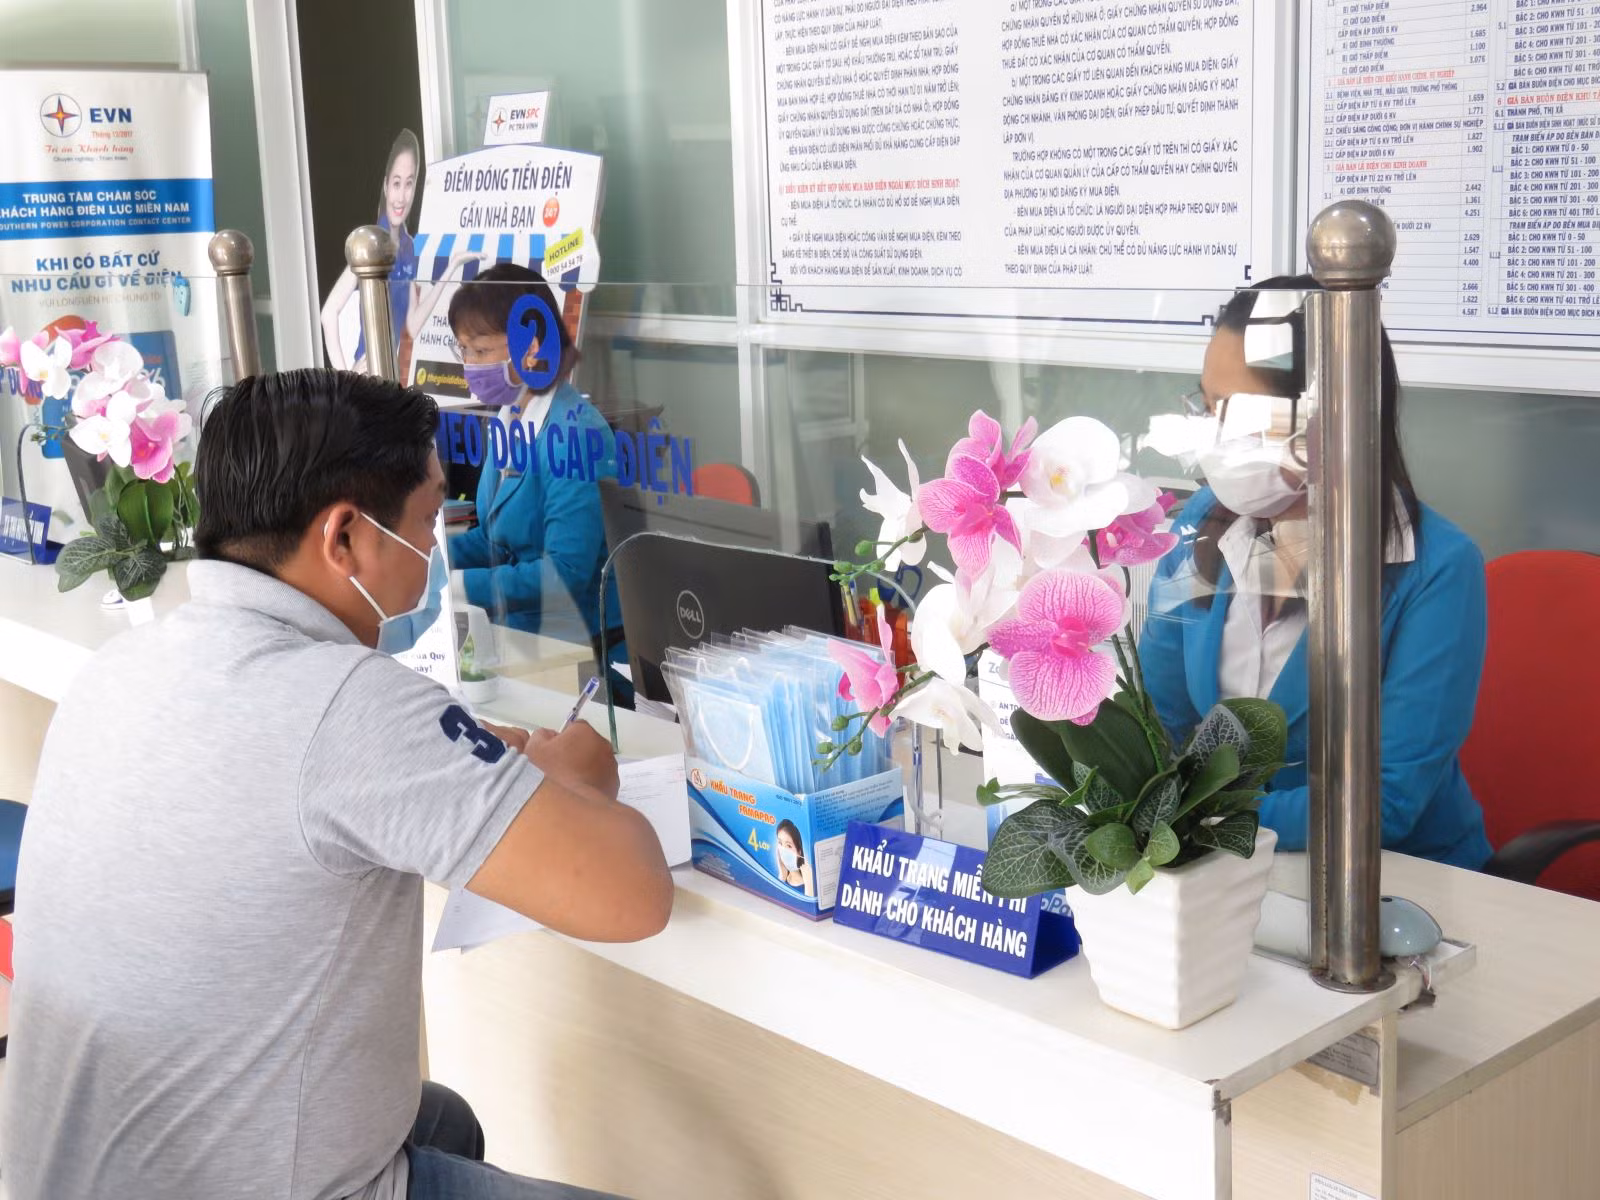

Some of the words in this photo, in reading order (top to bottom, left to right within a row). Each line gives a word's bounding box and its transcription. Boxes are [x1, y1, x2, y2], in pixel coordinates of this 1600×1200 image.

[90, 108, 132, 123] EVN
[444, 162, 473, 192] ĐIỂM
[475, 165, 508, 191] ĐÓNG
[512, 160, 539, 190] TIỀN
[541, 161, 573, 196] ĐIỆN
[23, 193, 65, 204] TRUNG
[69, 189, 93, 202] TÂM
[97, 189, 131, 202] CHĂM
[134, 188, 157, 200] SÓC
[41, 203, 73, 217] HÀNG
[77, 202, 105, 216] ĐIỆN
[136, 200, 161, 214] MIỀN
[165, 202, 189, 213] NAM
[41, 220, 69, 229] POWER
[71, 219, 126, 228] CORPORATION
[128, 217, 160, 226] CONTACT
[162, 216, 191, 225] CENTER
[459, 202, 482, 228] GẦN
[484, 202, 508, 229] NHÀ
[511, 205, 535, 233] BẠN
[36, 258, 68, 271] KHI
[73, 252, 95, 269] CÓ
[100, 246, 133, 268] BẤT
[138, 250, 160, 267] CỨ
[548, 237, 580, 263] HOTLINE
[12, 278, 52, 293] NHU
[56, 272, 91, 291] CẦU
[95, 273, 113, 288] GÌ
[119, 268, 140, 287] VỀ
[520, 307, 549, 372] 2
[490, 405, 541, 475] DÕI
[547, 402, 604, 482] CẤP
[615, 416, 694, 505] ĐIỆN
[680, 606, 702, 624] DELL
[439, 704, 506, 763] 3
[710, 779, 729, 798] KHẨU
[729, 787, 756, 805] TRANG
[738, 804, 776, 825] FAMAPRO
[852, 840, 894, 879] KHẨU
[898, 856, 950, 894] TRANG
[841, 883, 882, 917] DÀNH
[886, 896, 919, 926] CHO
[922, 904, 978, 944] KHÁCH
[980, 918, 1028, 959] HÀNG
